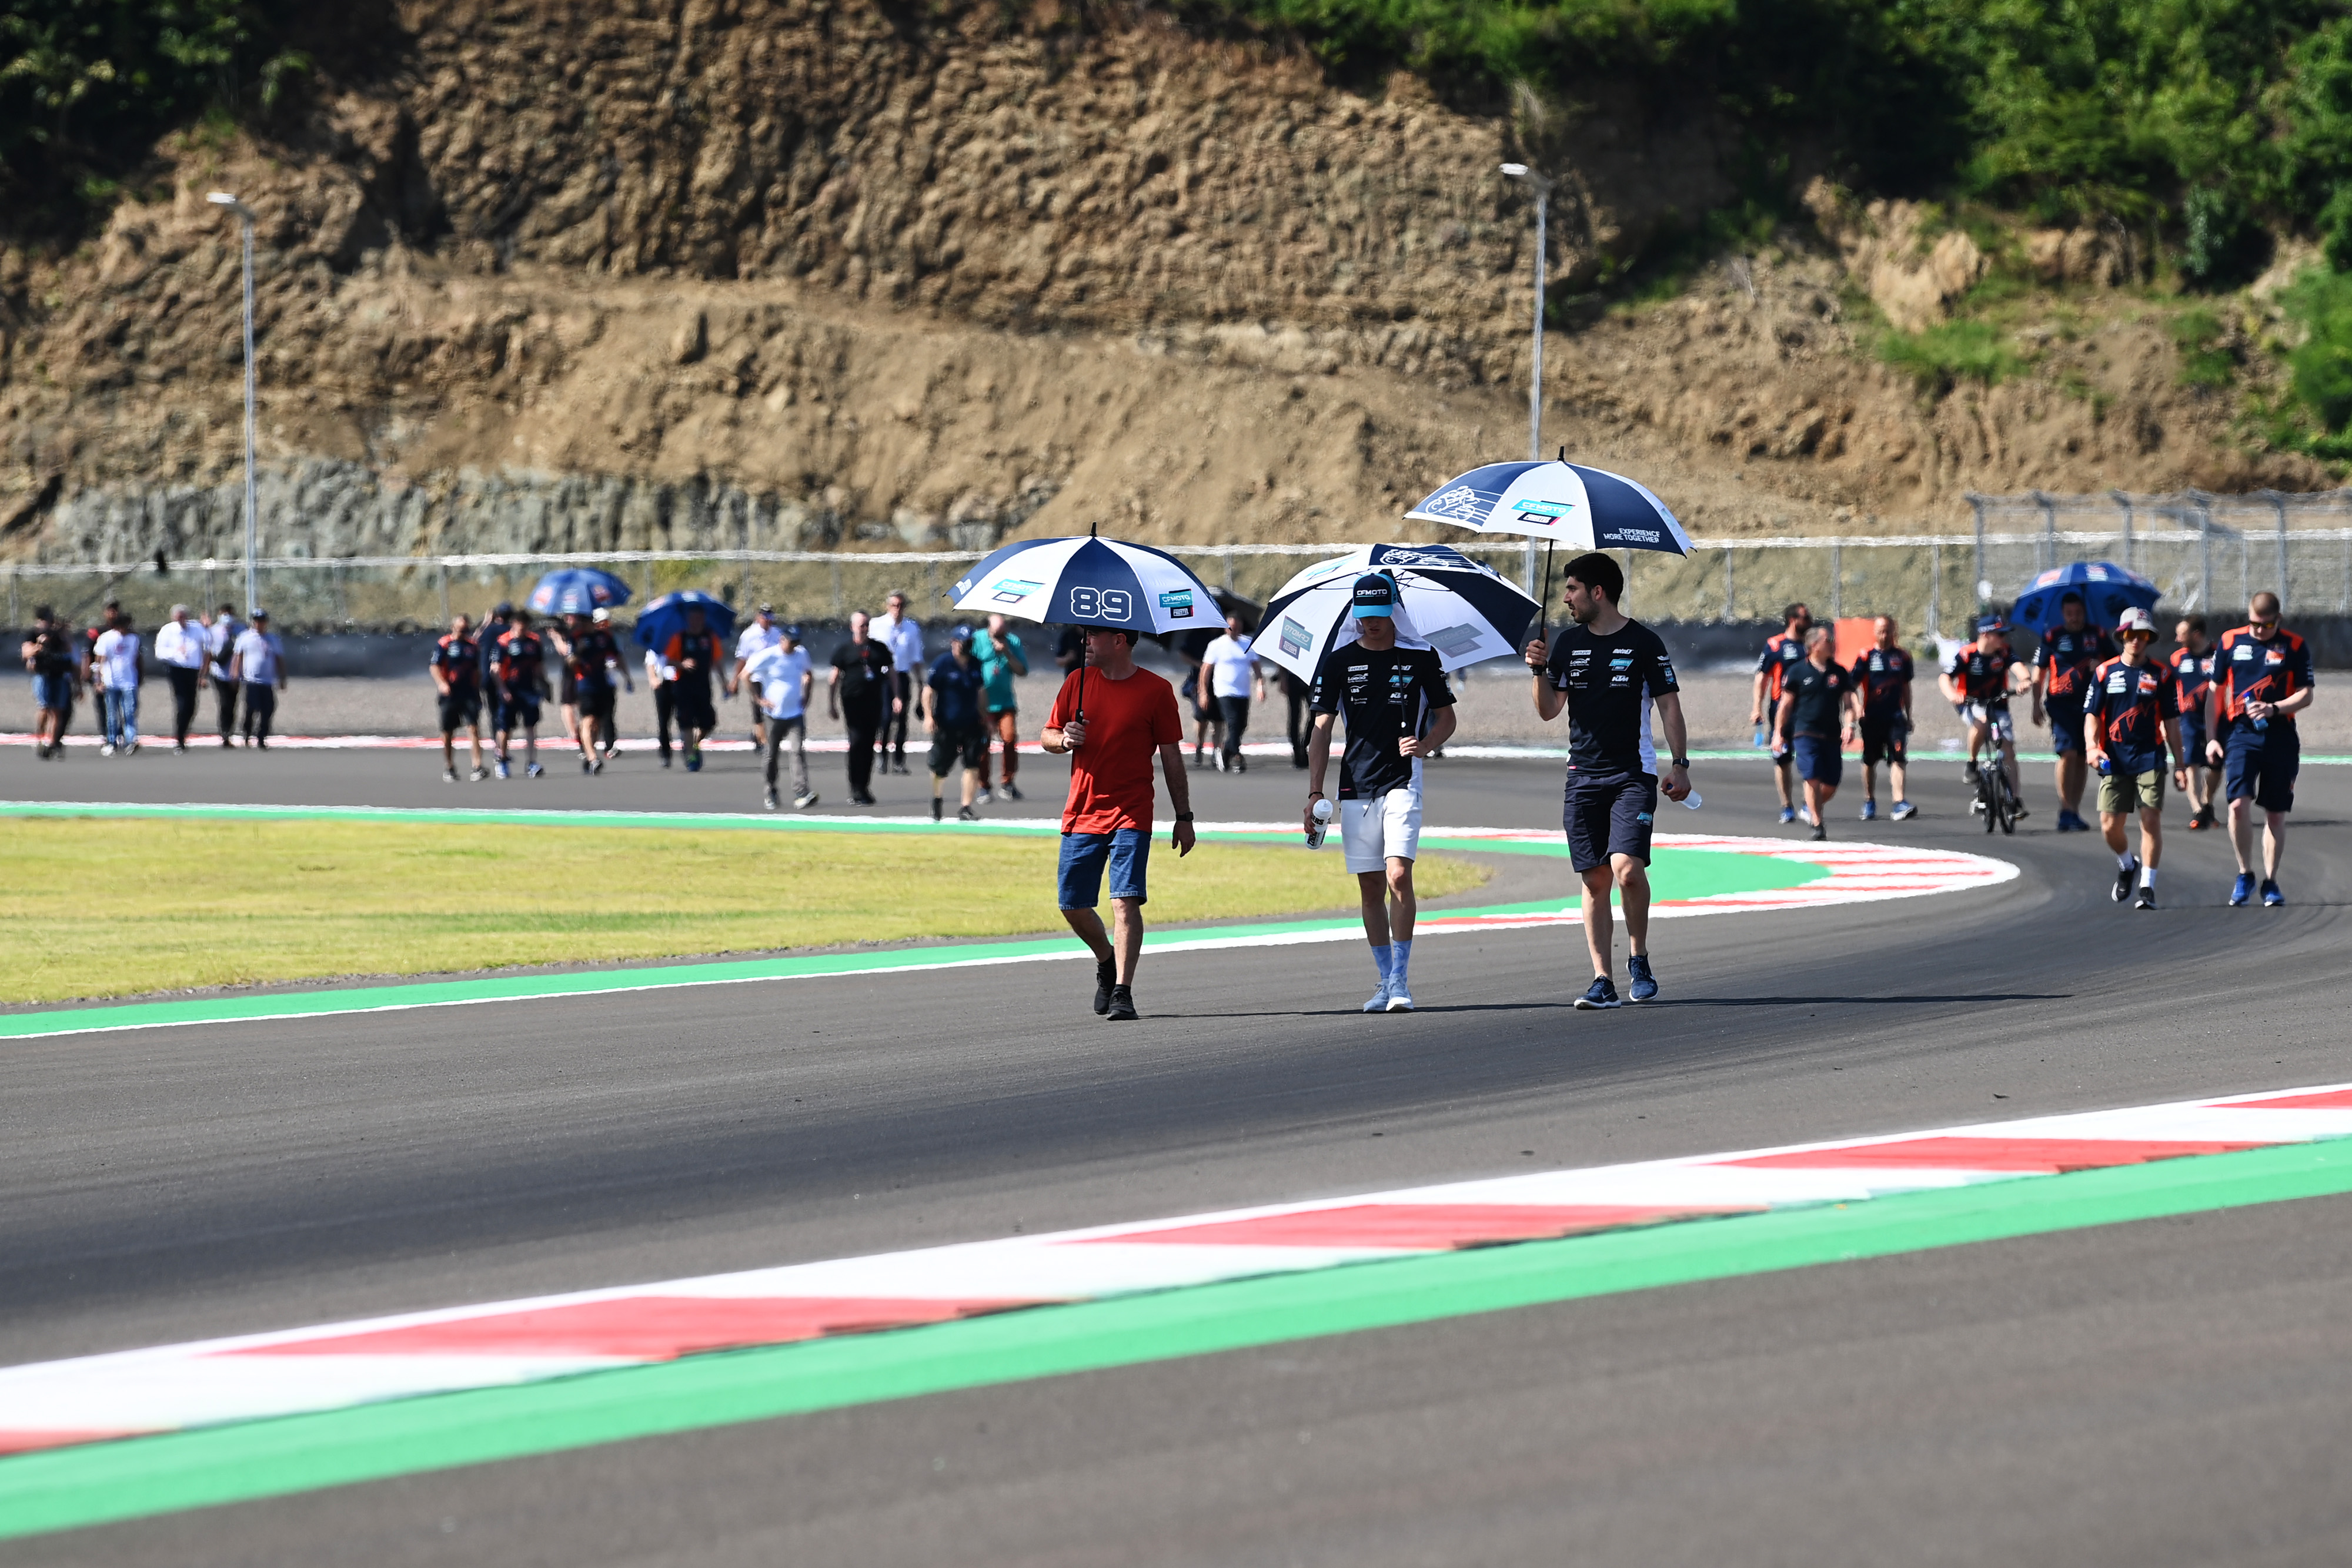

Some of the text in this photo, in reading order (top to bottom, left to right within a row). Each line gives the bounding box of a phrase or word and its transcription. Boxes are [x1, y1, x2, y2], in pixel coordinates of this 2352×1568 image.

[1522, 502, 1566, 513] CFMOTO
[1618, 528, 1660, 537] EXPERIENCE
[1623, 534, 1659, 543] TOGETHER
[1161, 594, 1191, 603] CFMOTO
[1070, 586, 1132, 622] 89
